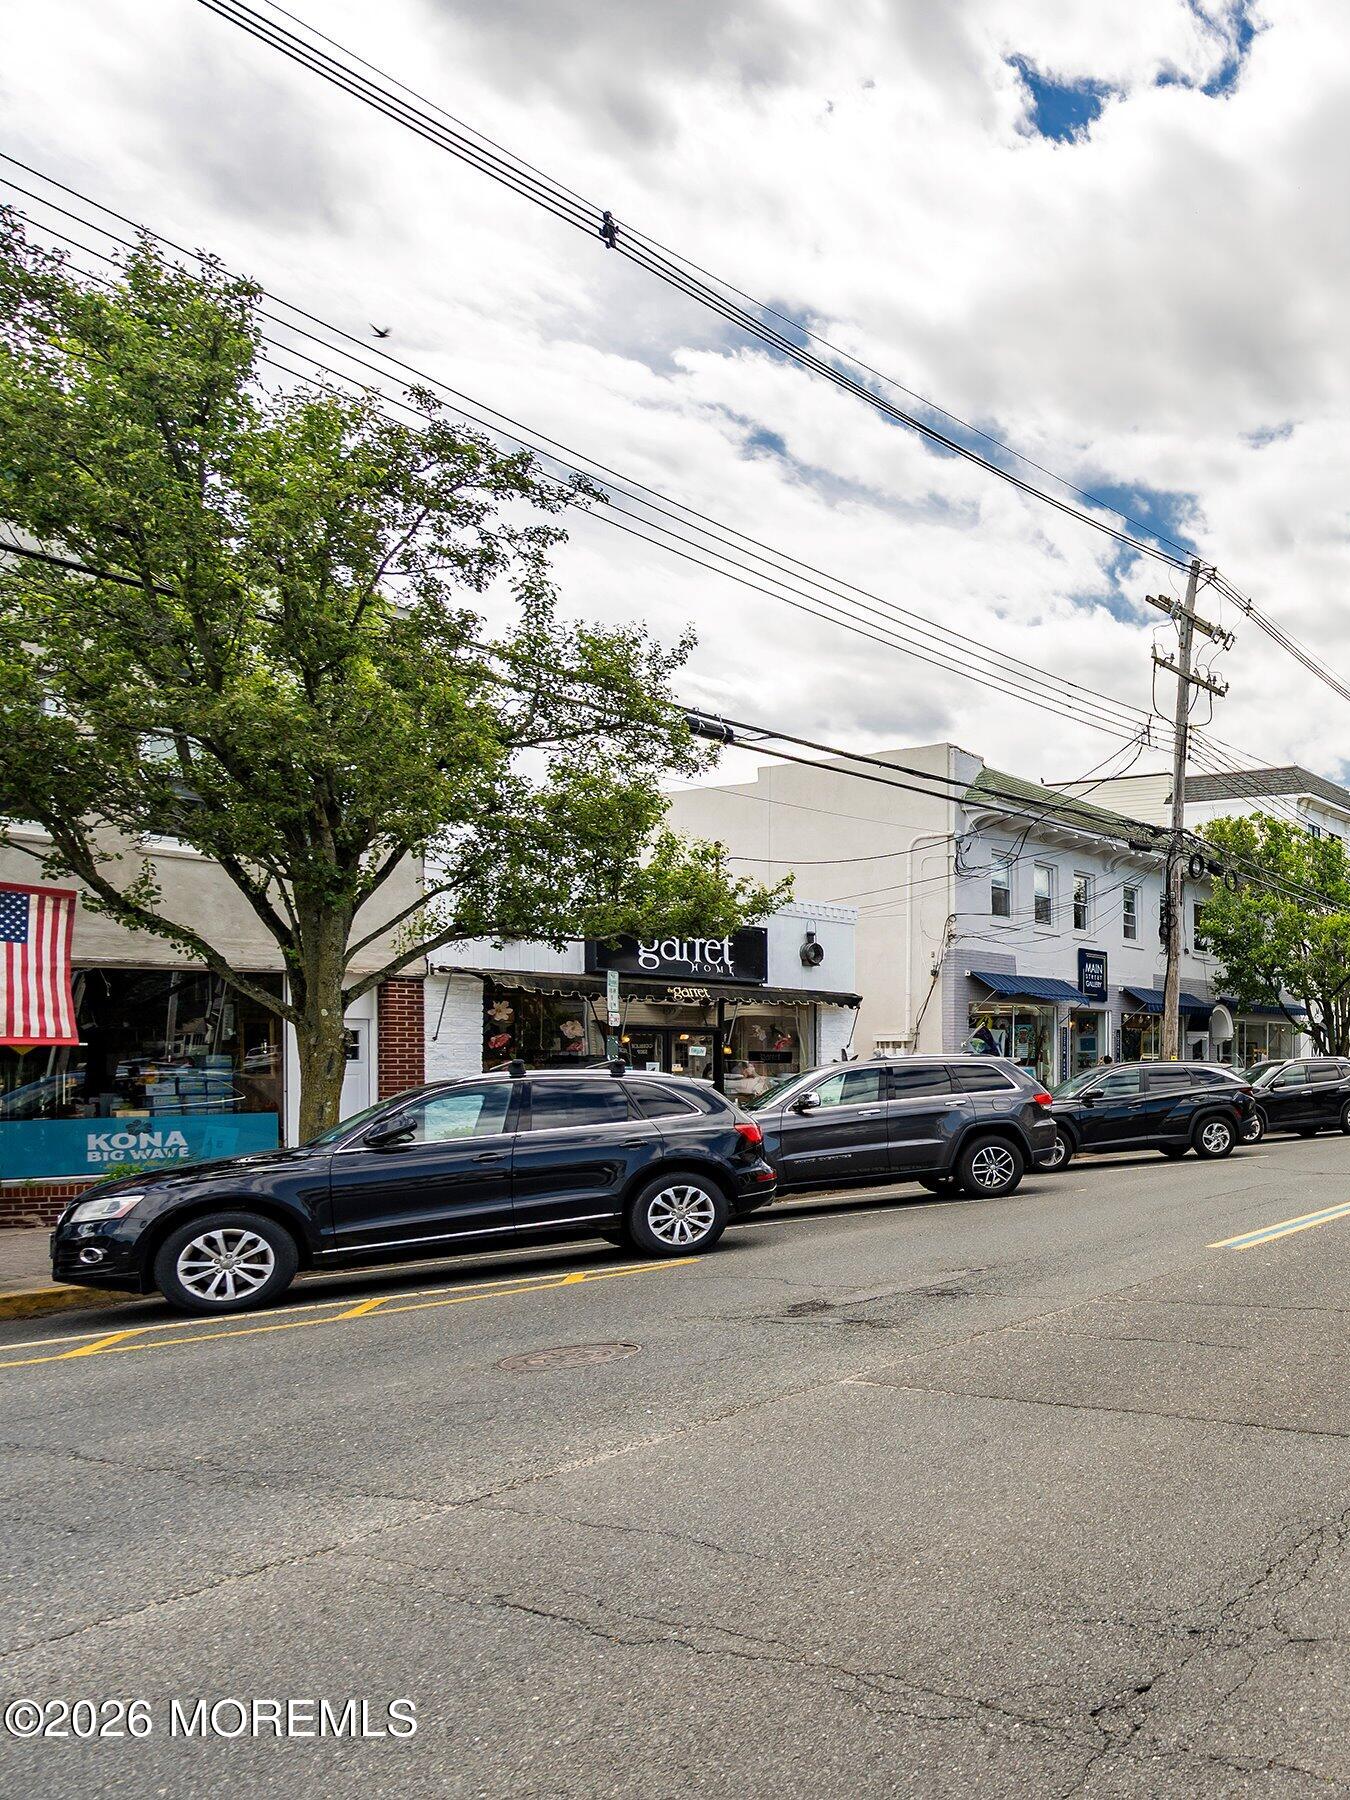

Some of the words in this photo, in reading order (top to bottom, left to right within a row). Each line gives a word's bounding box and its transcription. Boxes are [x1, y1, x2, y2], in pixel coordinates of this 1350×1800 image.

[1085, 962, 1103, 974] MAIN
[1085, 980, 1103, 988] GALLERY
[673, 987, 711, 1000] garret
[87, 1130, 188, 1150] KONA
[87, 1151, 125, 1162] BIG
[131, 1147, 189, 1160] WAVE
